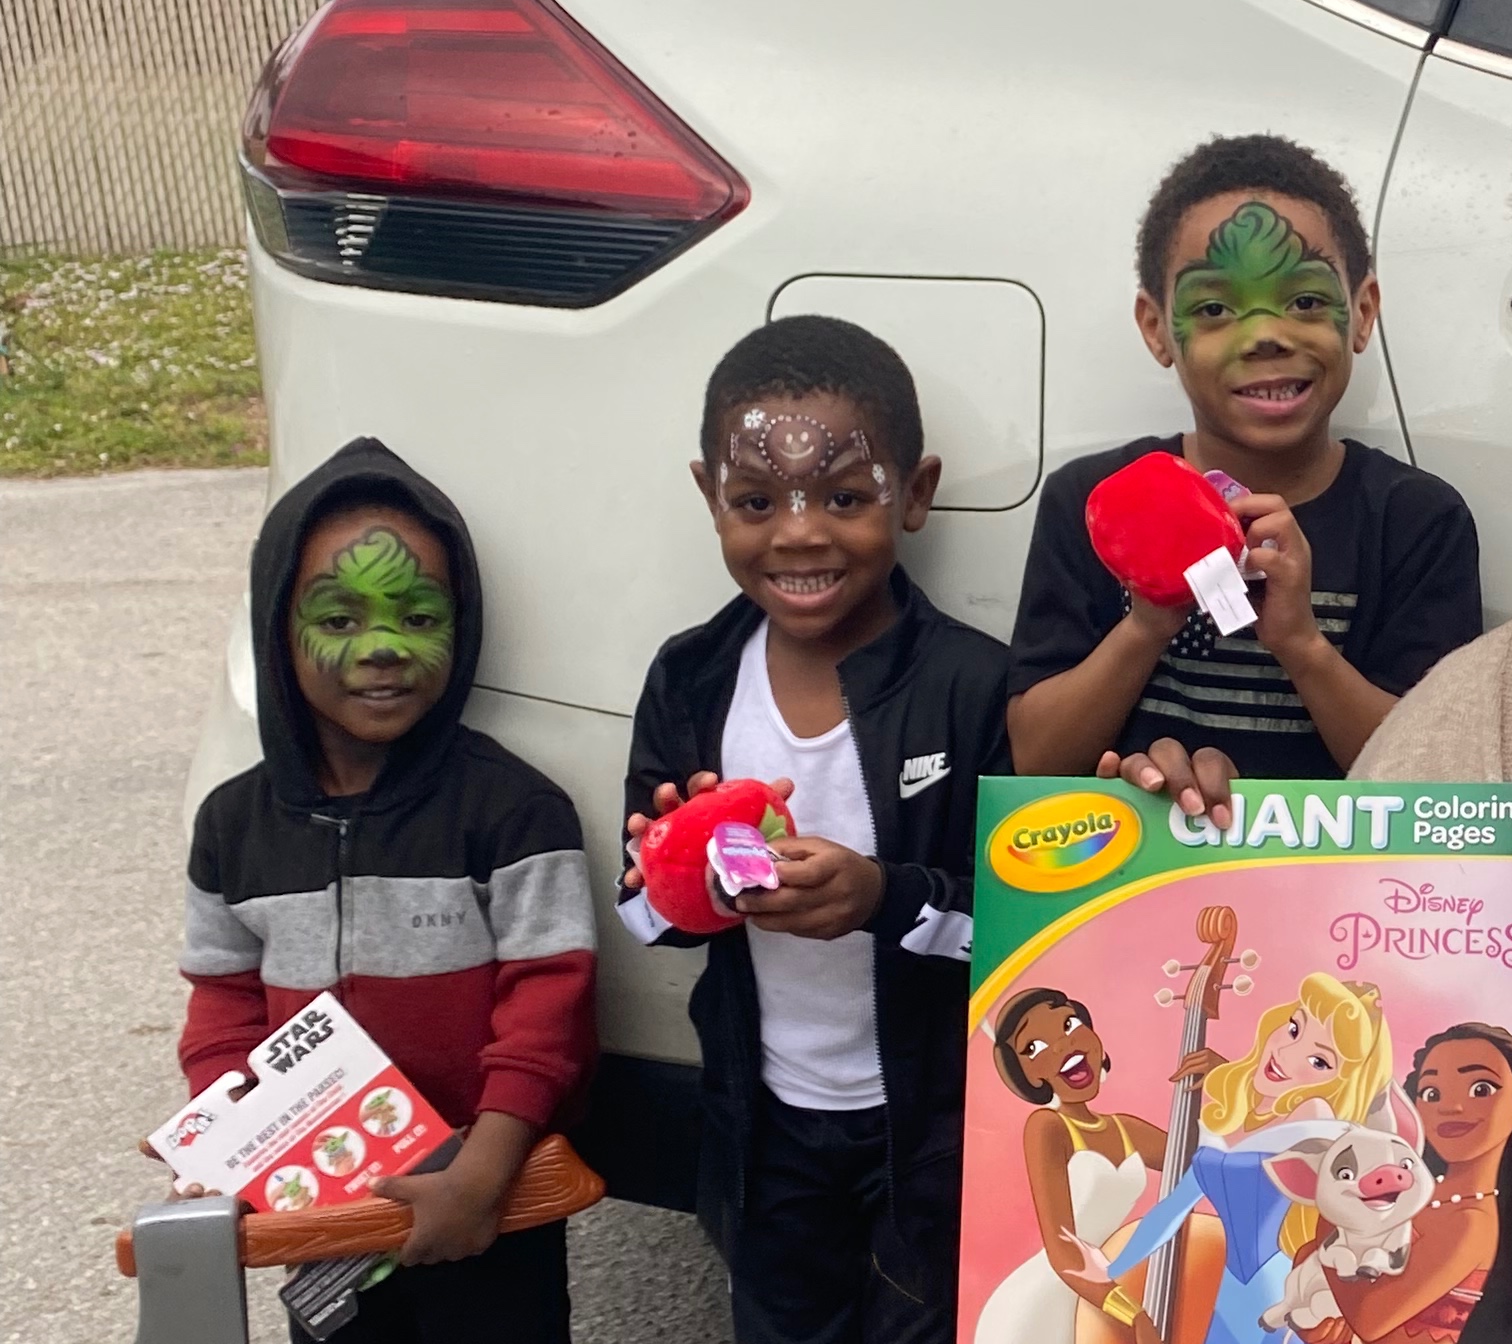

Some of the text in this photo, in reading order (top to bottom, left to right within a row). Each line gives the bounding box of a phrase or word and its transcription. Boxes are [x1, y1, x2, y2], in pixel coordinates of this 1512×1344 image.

[903, 752, 946, 781] NIKE
[1012, 810, 1115, 851] Crayola
[1412, 820, 1496, 851] Pages
[266, 1009, 328, 1065] STAR
[271, 1018, 334, 1075] WARS
